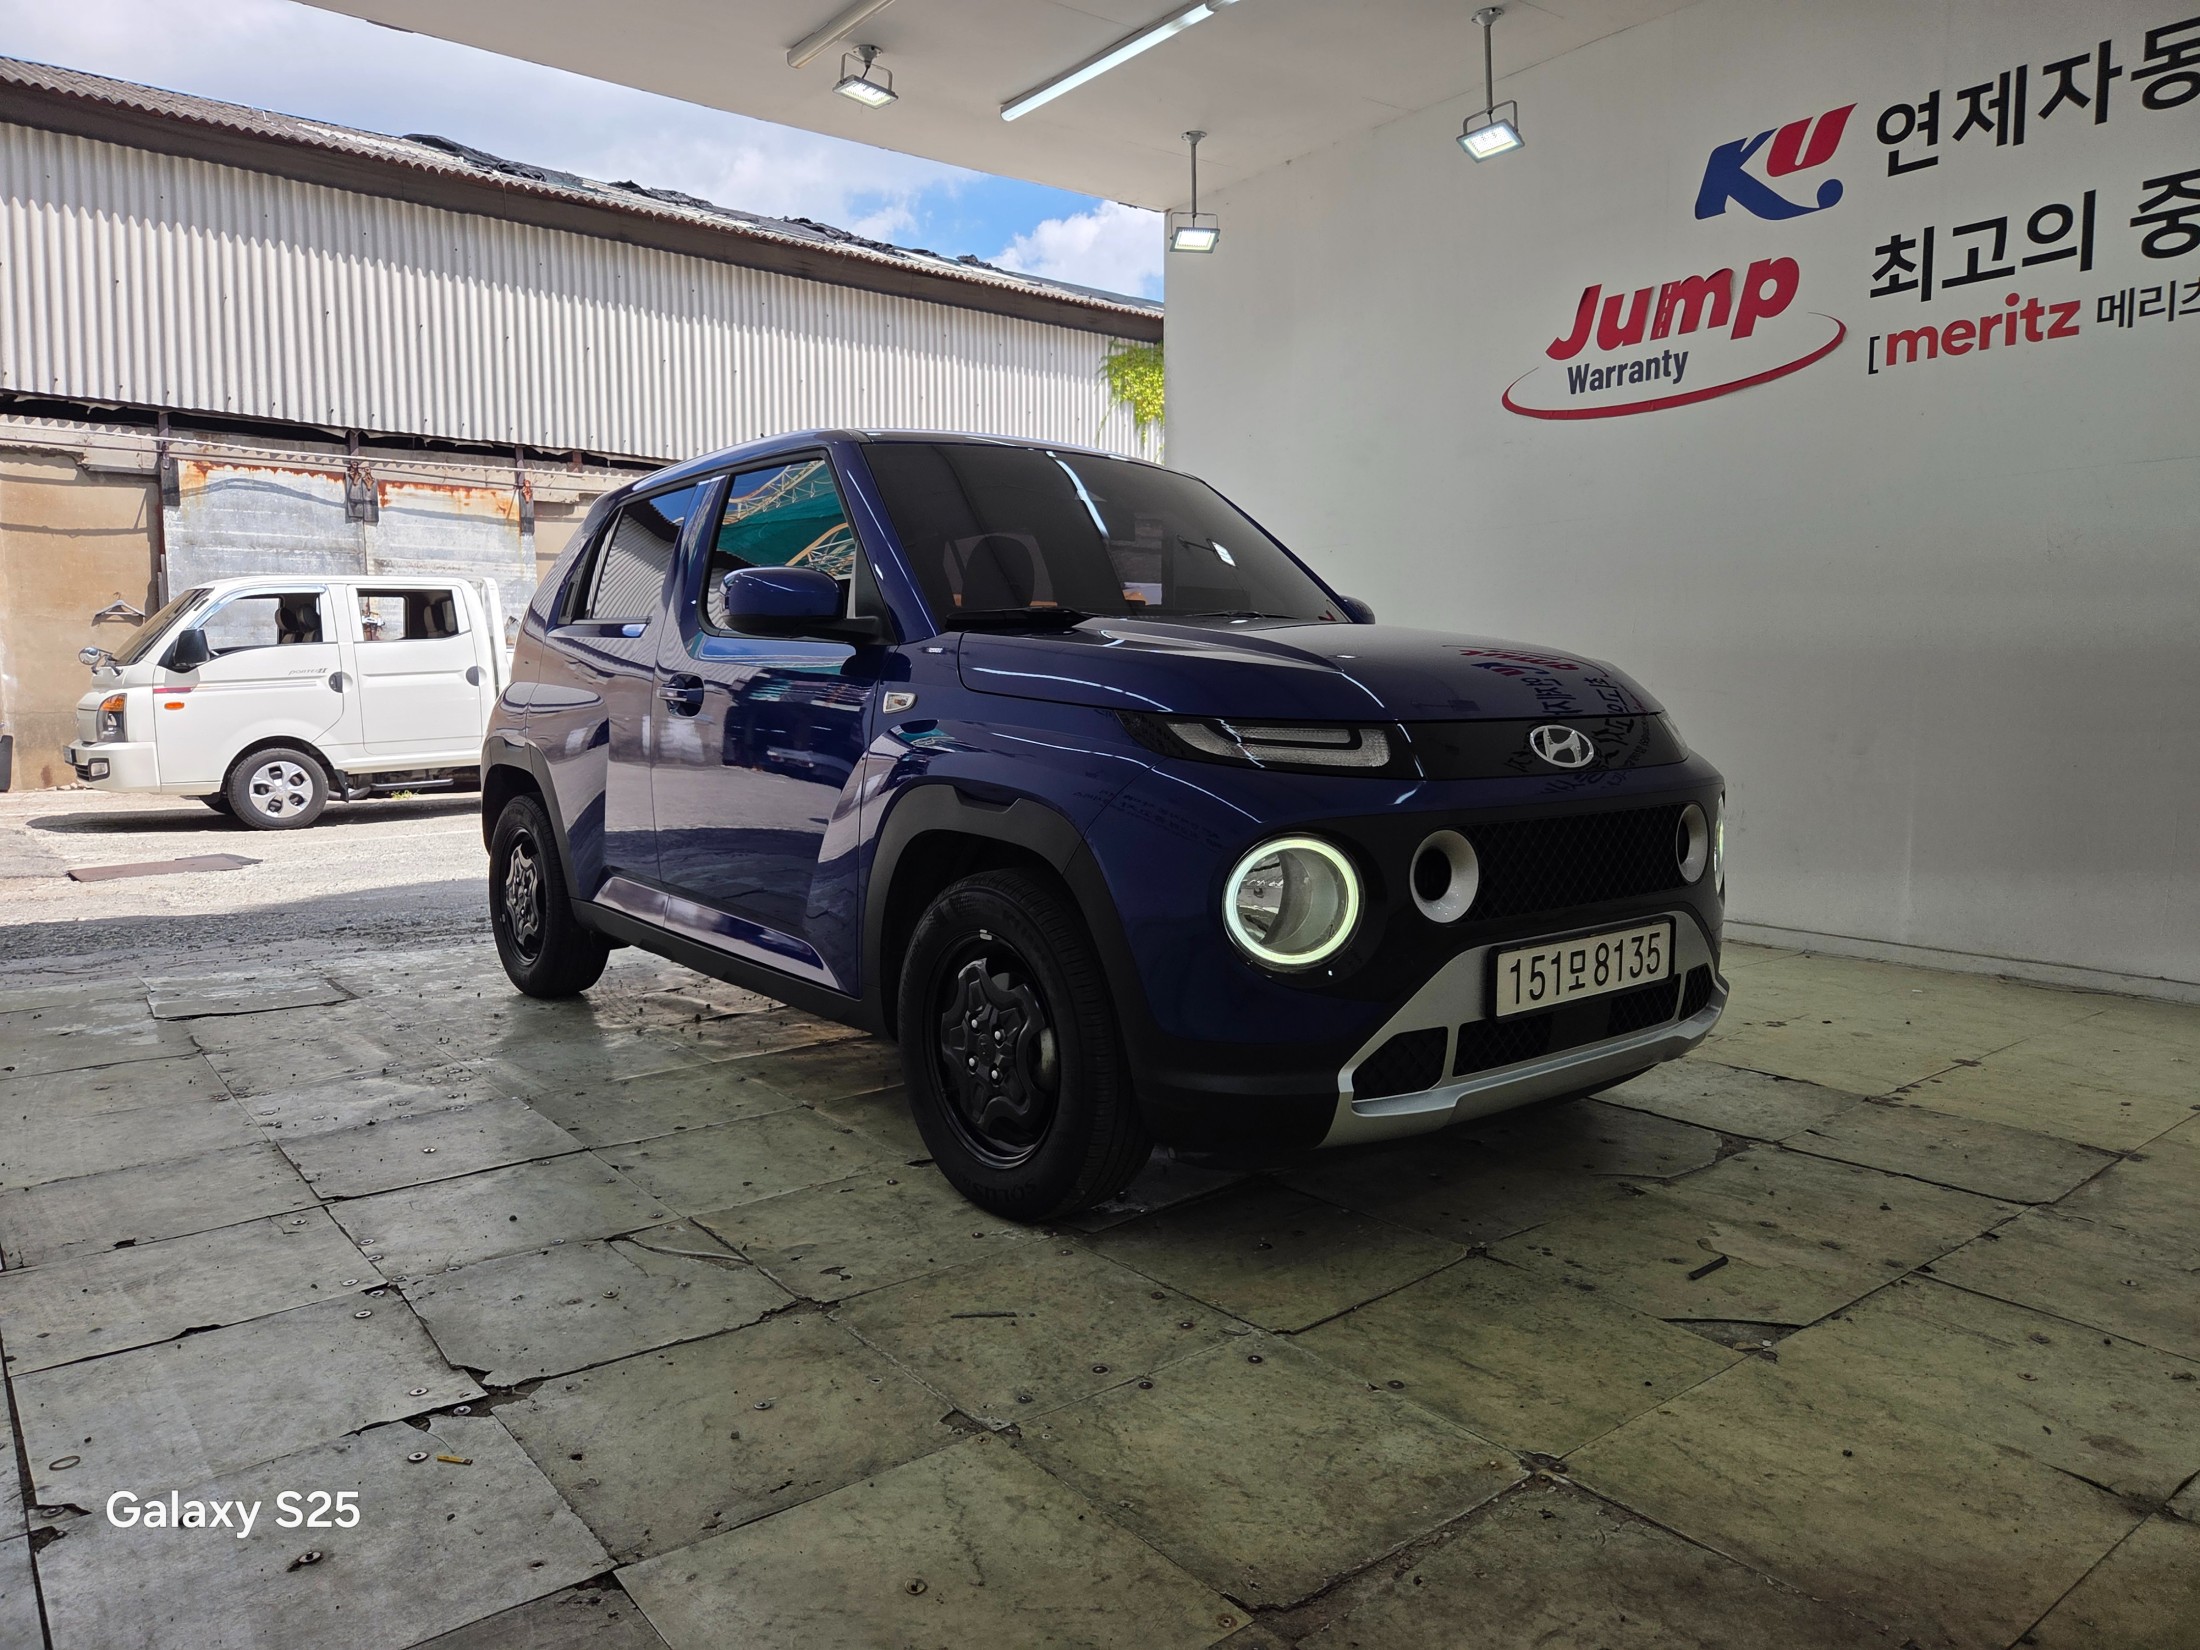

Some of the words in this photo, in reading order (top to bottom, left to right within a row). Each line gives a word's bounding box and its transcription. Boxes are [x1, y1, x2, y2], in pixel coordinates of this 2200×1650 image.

[1870, 190, 2097, 301] 최고의
[1546, 257, 1799, 360] Jump
[1568, 350, 1690, 394] Warranty
[1510, 932, 1661, 1005] 151모8135
